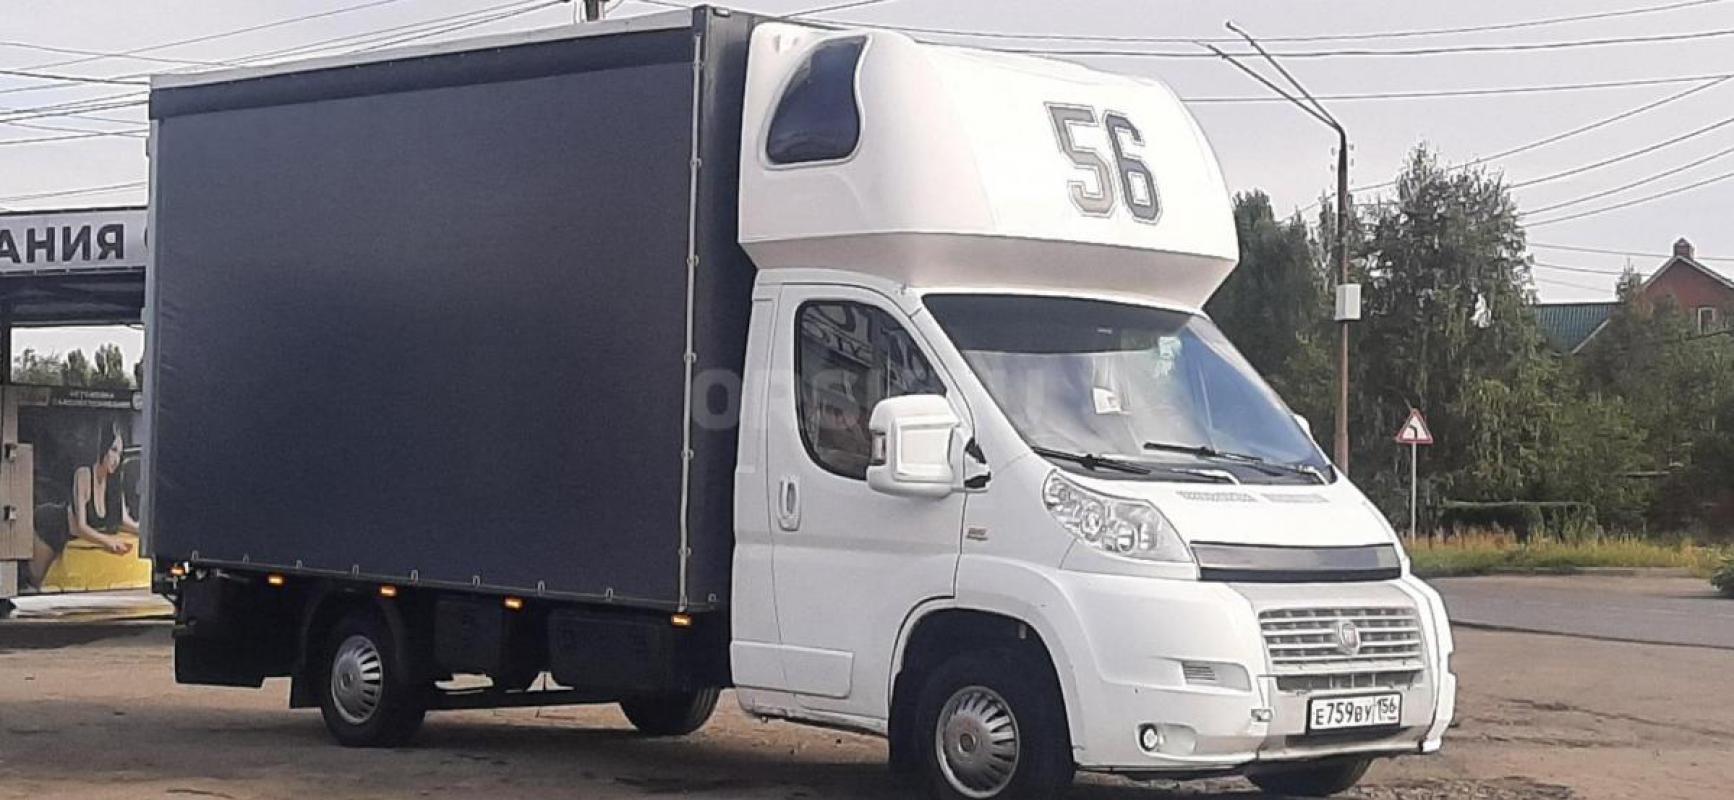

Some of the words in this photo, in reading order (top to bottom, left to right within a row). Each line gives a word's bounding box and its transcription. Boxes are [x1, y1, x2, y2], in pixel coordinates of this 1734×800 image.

[1044, 101, 1163, 225] 56
[0, 224, 124, 263] АНИЯ
[1377, 697, 1397, 721] 156
